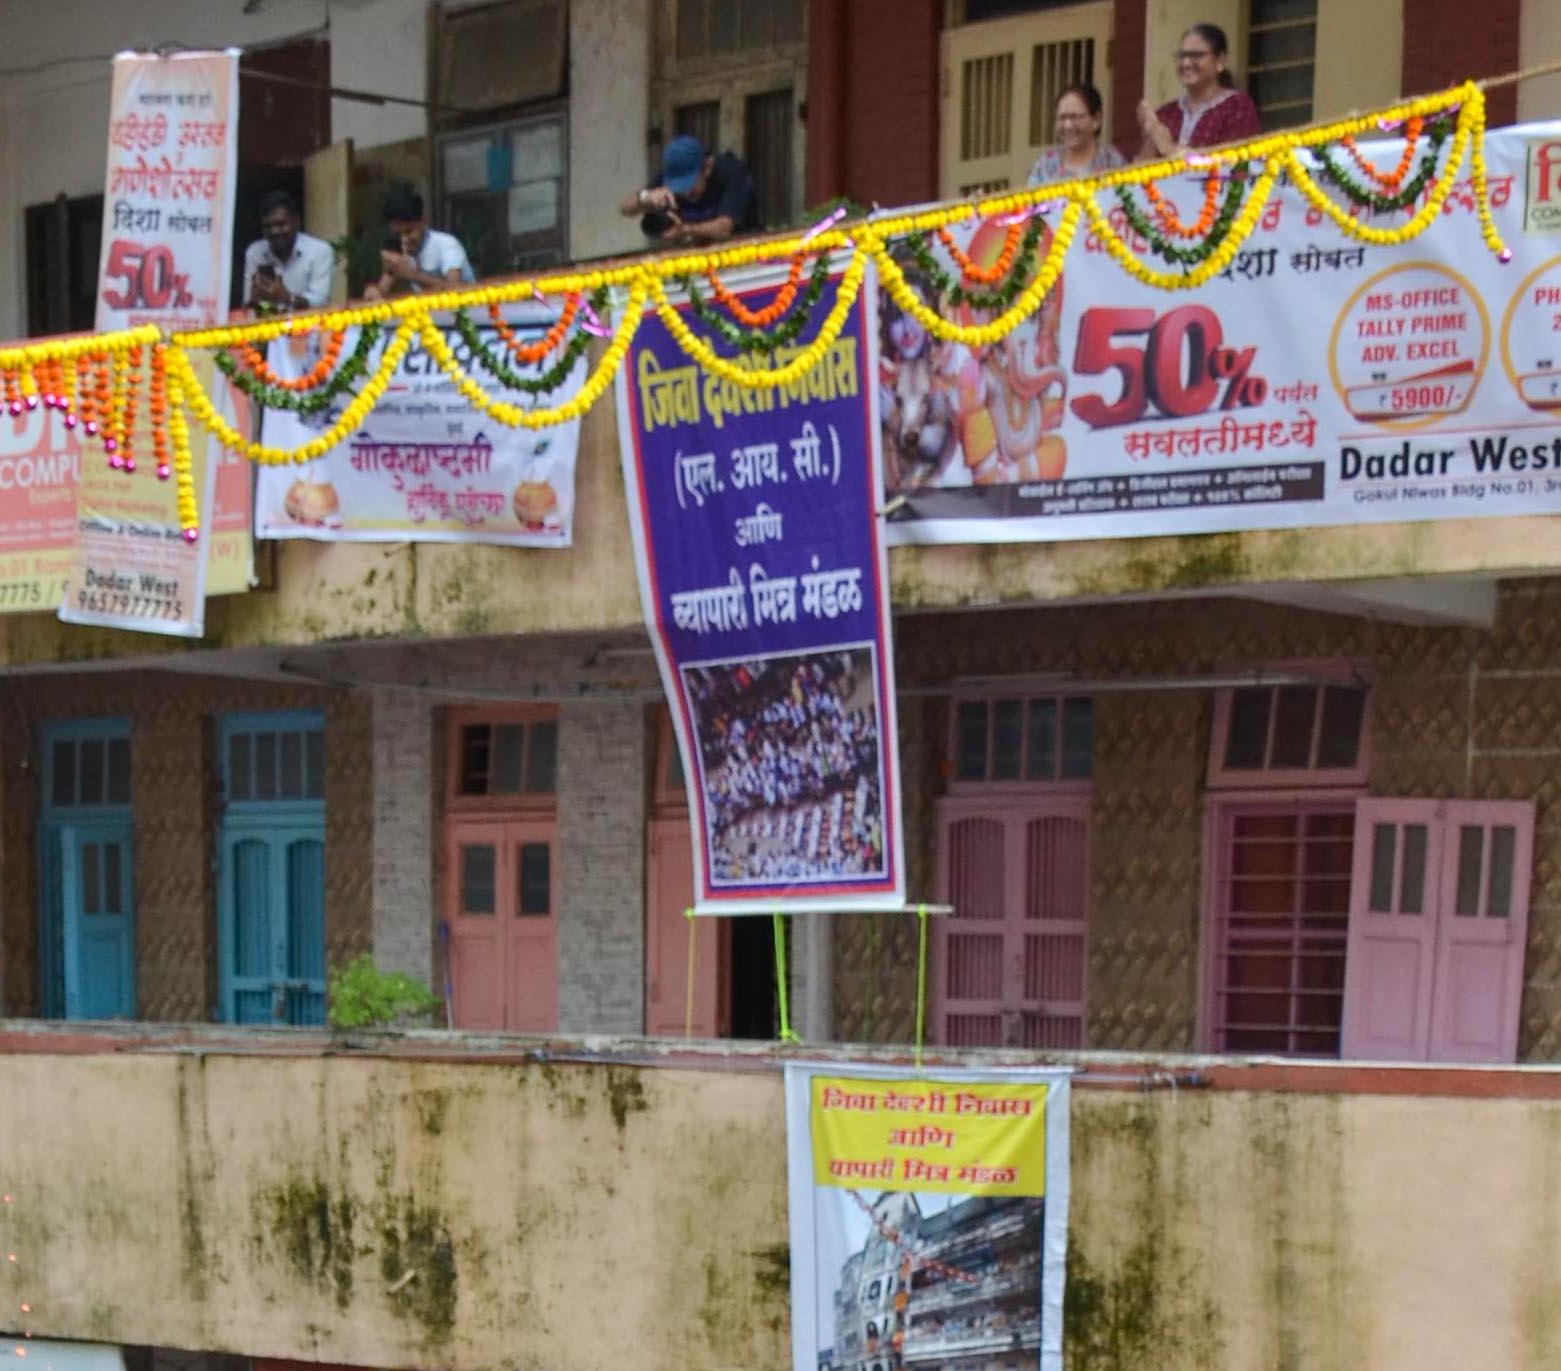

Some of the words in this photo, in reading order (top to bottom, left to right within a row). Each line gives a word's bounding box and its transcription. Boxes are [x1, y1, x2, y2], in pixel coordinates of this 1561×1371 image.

[102, 239, 192, 311] 50%
[1290, 242, 1366, 274] सोबत
[1365, 287, 1460, 311] MS-OFFICE
[1357, 317, 1405, 339] TALLY
[1410, 312, 1467, 333] PRIME
[1070, 303, 1268, 431] 50%
[1361, 343, 1399, 363] ADV.
[1405, 337, 1460, 360] EXCEL
[1390, 384, 1462, 412] 5900/-
[1123, 409, 1318, 462] सवलतीमध्ये
[1341, 440, 1454, 481] Dadar
[1470, 434, 1561, 474] West
[730, 442, 788, 490] आय.
[734, 502, 783, 546] आणि
[85, 567, 133, 591] Dadar
[140, 574, 179, 597] West
[670, 565, 748, 635] व्यापारी
[749, 562, 798, 626] मित्र
[800, 553, 863, 619] मंडळ
